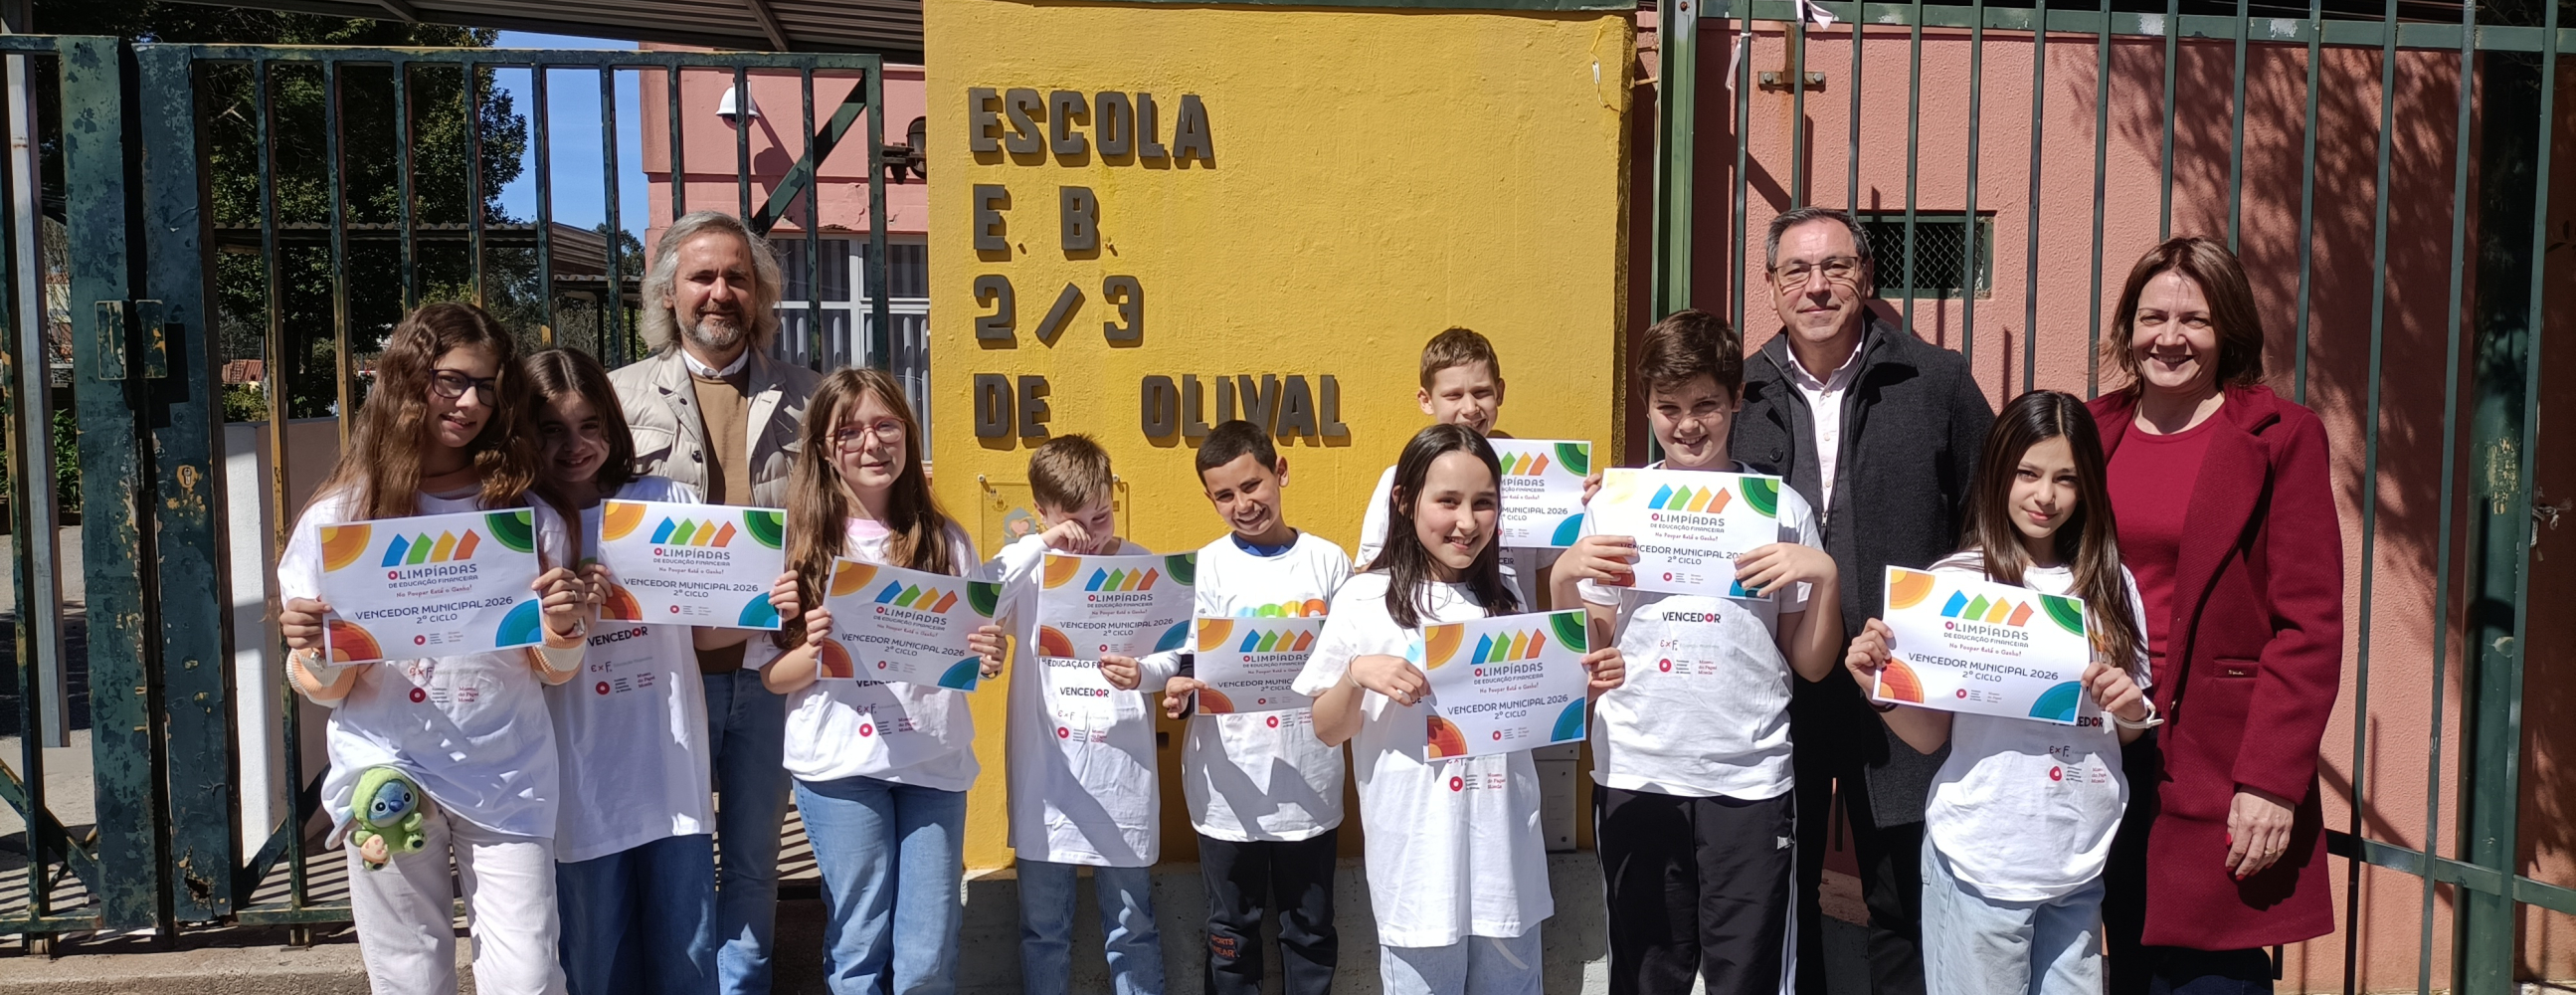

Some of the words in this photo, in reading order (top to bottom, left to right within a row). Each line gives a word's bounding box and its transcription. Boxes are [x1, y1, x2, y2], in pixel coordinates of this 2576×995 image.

[969, 87, 1212, 160] ESCOLA
[974, 373, 1046, 439] DE
[1141, 373, 1347, 439] OLIVAL
[1502, 477, 1545, 487] MPÍADAS
[1652, 513, 1725, 526] OLIMPÍADAS
[654, 547, 730, 559] OLIMPÍADAS
[1673, 547, 1724, 559] MUNICIPAL
[388, 564, 476, 580] OLIMPÍADAS
[399, 579, 437, 588] EDUCAÇÃO
[439, 575, 478, 584] FINANCEIRA
[624, 578, 676, 588] VENCEDOR
[679, 582, 731, 591] MUNICIPAL
[1088, 593, 1153, 602] OLIMPÍADAS
[355, 606, 419, 620] VENCEDOR
[422, 600, 482, 614] MUNICIPAL
[485, 596, 513, 607] 2026
[430, 613, 458, 622] CICLO
[876, 606, 947, 625] OLIMPÍADAS
[1662, 612, 1721, 623] VENCEDOR
[1154, 618, 1173, 627] 2026
[587, 626, 648, 647] VENCEDOR
[1945, 621, 2029, 641] OLIMPÍADAS
[841, 634, 890, 645] VENCEDOR
[891, 639, 940, 654] MUNICIPAL
[941, 648, 965, 657] 2026
[1953, 634, 1989, 643] EDUCAÇÃO
[1990, 639, 2029, 648] FINANCEIRA
[1047, 659, 1090, 669] EDUCAÇÃO
[1243, 654, 1309, 663] OLIMPÍADAS
[1474, 663, 1544, 677] OLIMPÍADAS
[1909, 653, 1967, 668] VENCEDOR
[1969, 662, 2028, 677] MUNICIPAL
[2030, 669, 2058, 681] 2026
[1975, 673, 2002, 683] CICLO
[1060, 688, 1110, 697] VENCEDOR
[1447, 702, 1497, 715] VENCEDOR
[1499, 697, 1546, 709] MUNICIPAL
[1547, 695, 1568, 704] 2026
